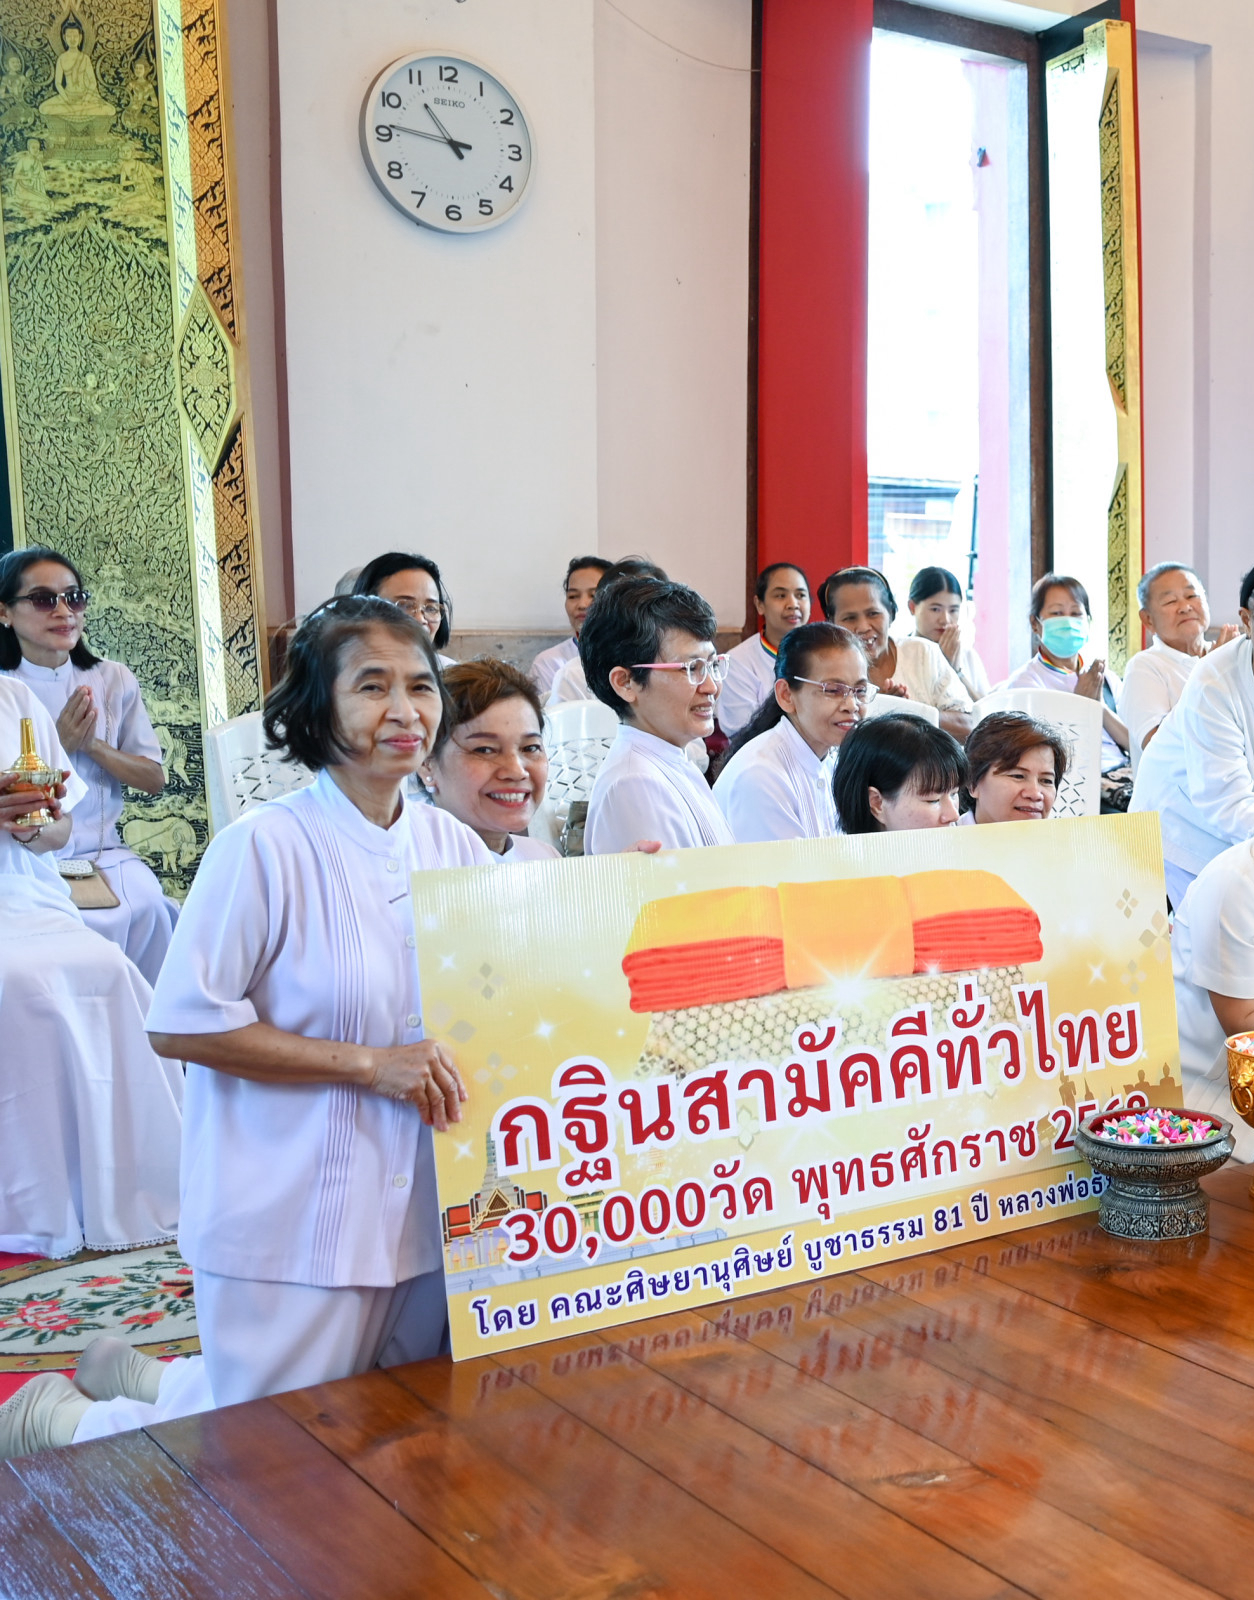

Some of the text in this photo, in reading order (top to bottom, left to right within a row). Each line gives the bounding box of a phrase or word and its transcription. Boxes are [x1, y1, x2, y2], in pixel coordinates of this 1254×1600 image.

[408, 68, 422, 86] 11
[439, 65, 459, 83] 12
[479, 81, 484, 97] 1
[381, 91, 402, 109] 10
[433, 97, 466, 109] SEIKO
[499, 108, 514, 126] 2
[375, 124, 393, 143] 9
[507, 144, 523, 162] 3
[386, 160, 404, 180] 8
[498, 175, 514, 193] 4
[410, 190, 426, 209] 7
[478, 198, 494, 216] 5
[445, 204, 463, 222] 6
[499, 983, 1139, 1187] กฐินสามัคคีทั่วไทย
[791, 1119, 1038, 1220] พุทธศักราช
[472, 1299, 536, 1335] โดย
[550, 1234, 793, 1320] คณะศิษยานุศิษย์
[804, 1216, 924, 1271] บูชาธรรม
[934, 1205, 963, 1232] 81
[973, 1195, 989, 1223] ปี
